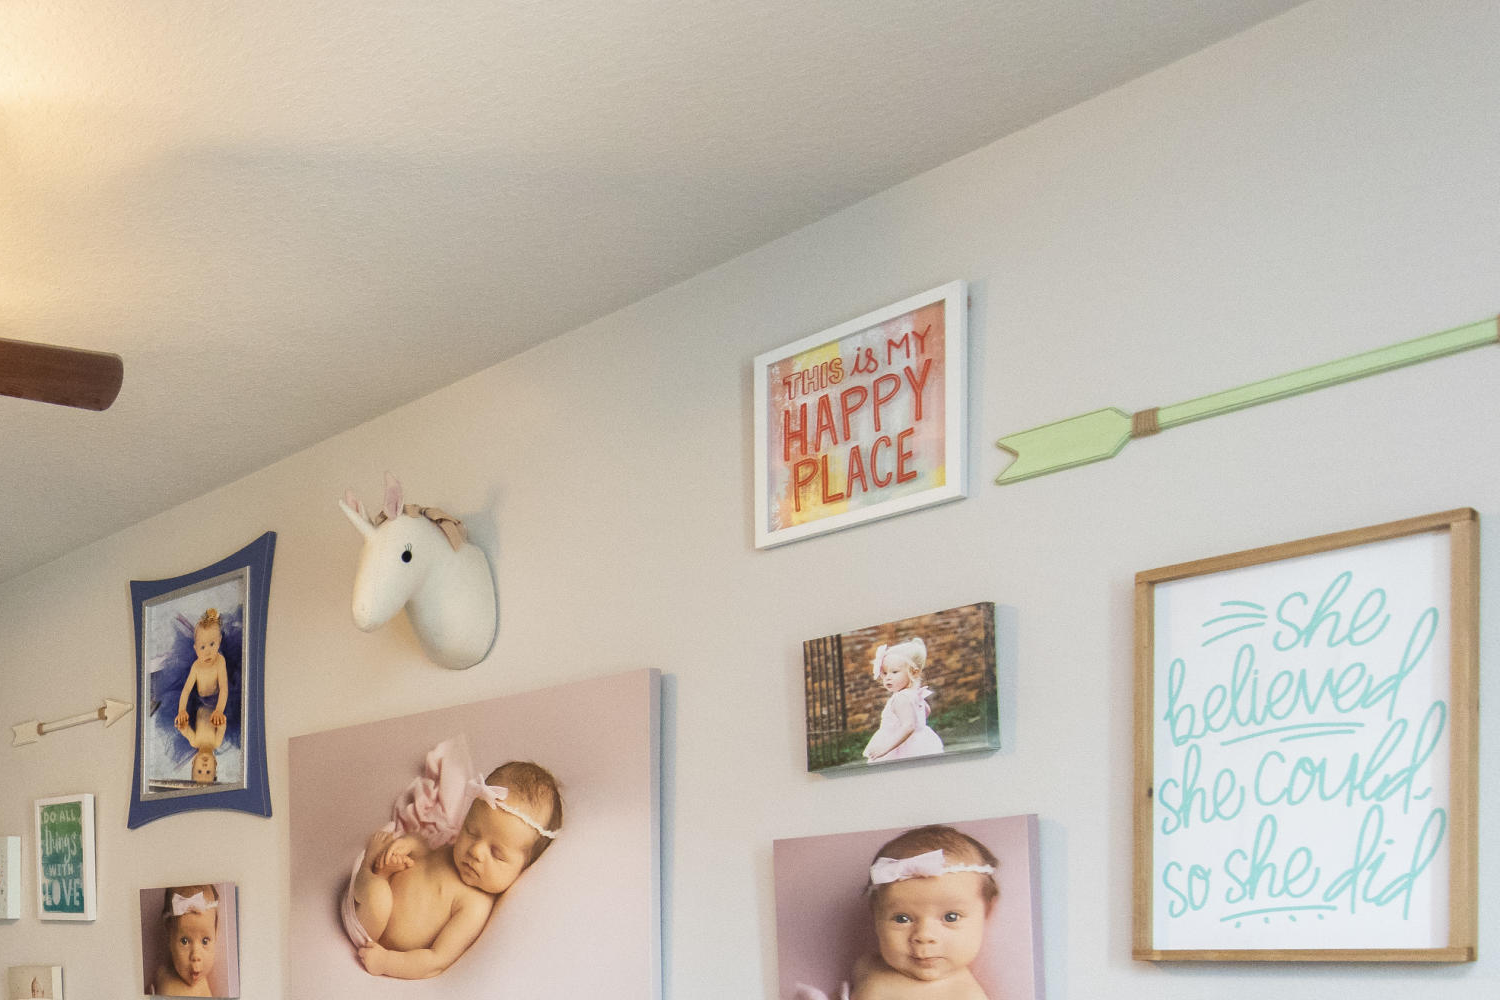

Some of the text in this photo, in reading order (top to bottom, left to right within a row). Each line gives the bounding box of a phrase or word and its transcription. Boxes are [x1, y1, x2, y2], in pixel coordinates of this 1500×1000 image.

[782, 323, 932, 401] THIS is MY
[783, 358, 932, 462] HAPPY
[793, 427, 917, 513] PLACE
[1272, 570, 1391, 652] she
[1163, 606, 1440, 747] believed
[1159, 700, 1447, 835] she could
[43, 808, 76, 824] DO ALL
[44, 878, 80, 906] LOVE
[49, 863, 74, 876] WITH
[1162, 804, 1447, 920] so she did
